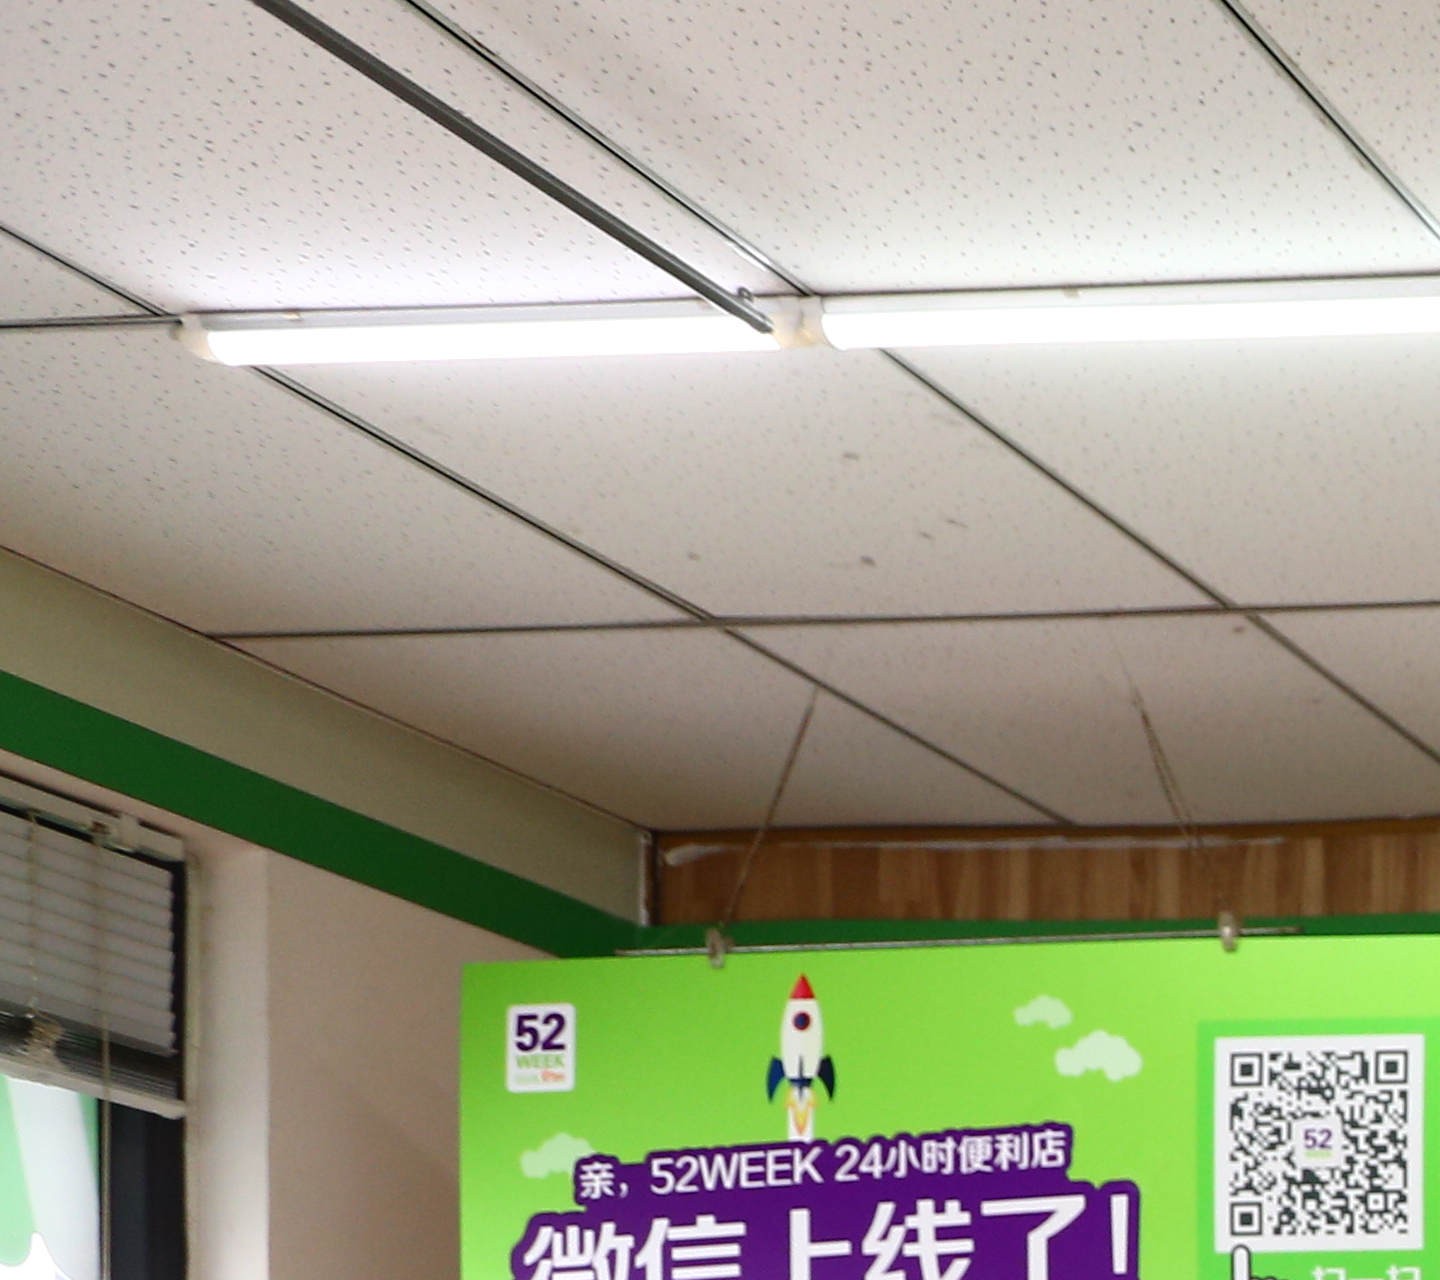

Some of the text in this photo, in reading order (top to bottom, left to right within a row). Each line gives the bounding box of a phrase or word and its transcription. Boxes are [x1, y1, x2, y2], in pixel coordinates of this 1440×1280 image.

[514, 1013, 567, 1053] 52
[515, 1053, 565, 1070] WEEK
[835, 1128, 1068, 1178] 24小时便利店
